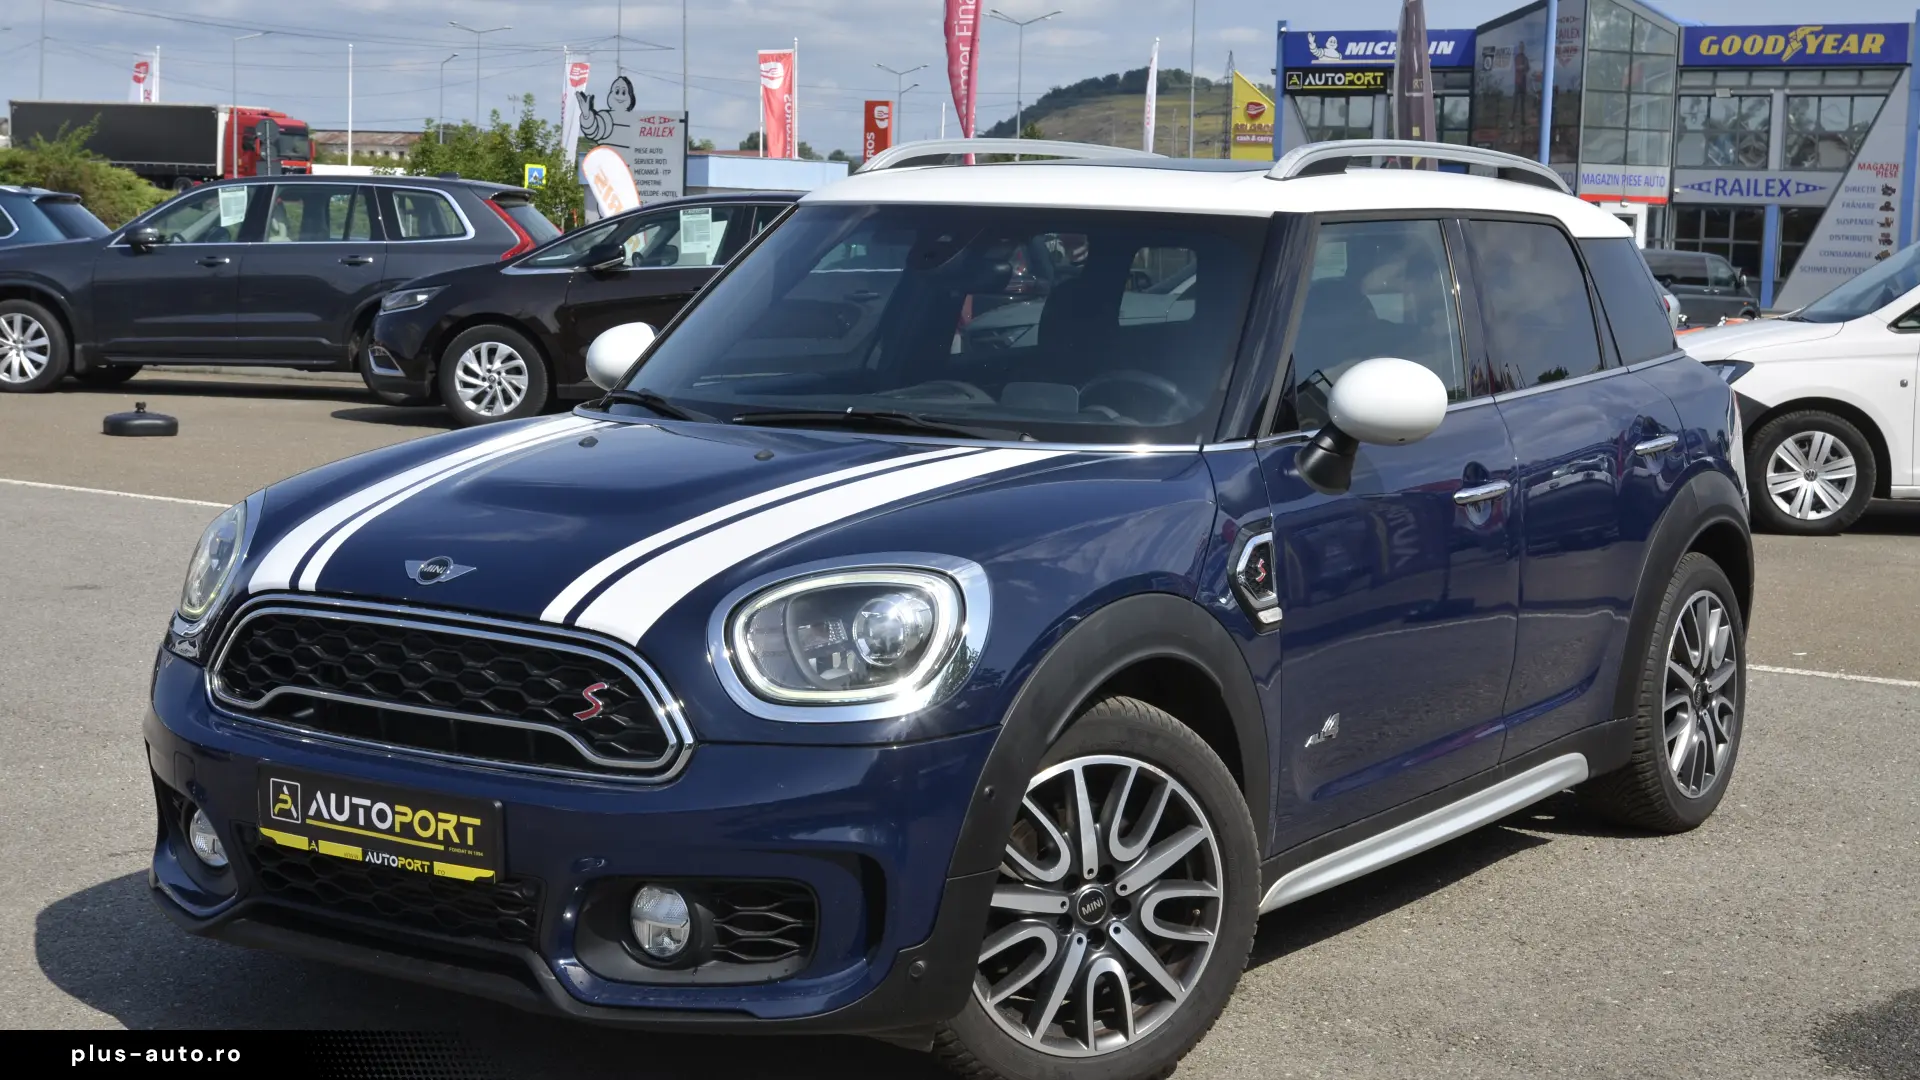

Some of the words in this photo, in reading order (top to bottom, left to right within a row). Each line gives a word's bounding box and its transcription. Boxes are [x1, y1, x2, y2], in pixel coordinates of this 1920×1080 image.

[1344, 41, 1455, 55] MICHIN
[1304, 72, 1384, 85] AUTOPORT
[639, 127, 675, 137] RAILEX
[866, 132, 876, 162] ROS
[1857, 163, 1899, 172] MAGAZIN
[1875, 170, 1899, 179] PIESE
[1581, 173, 1620, 186] MAGAZIN
[1621, 174, 1642, 187] PIESE
[1644, 175, 1666, 187] AUTO
[1714, 178, 1792, 197] RAILEX
[421, 564, 447, 574] MINI
[572, 682, 608, 721] S
[307, 790, 481, 846] AUTOPORT
[365, 850, 431, 873] AUTOPORT
[1081, 896, 1104, 916] MINI
